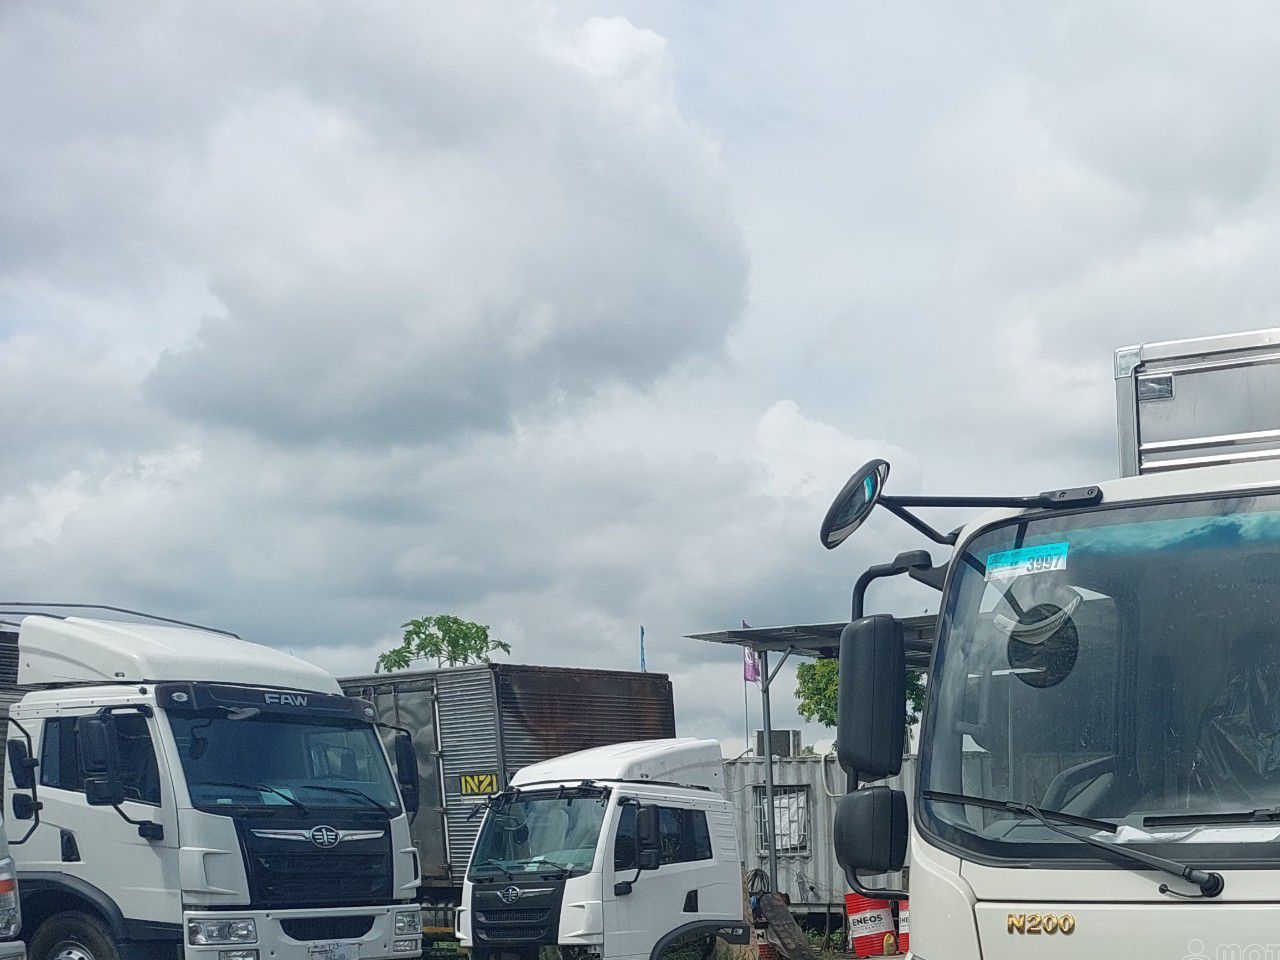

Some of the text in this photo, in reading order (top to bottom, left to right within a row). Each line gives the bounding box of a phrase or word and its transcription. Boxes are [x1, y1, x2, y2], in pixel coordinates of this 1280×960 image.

[1025, 553, 1063, 573] 3997
[264, 693, 308, 707] FAW
[852, 914, 883, 927] ENEOS
[899, 916, 910, 924] ENE
[1007, 913, 1076, 936] N200
